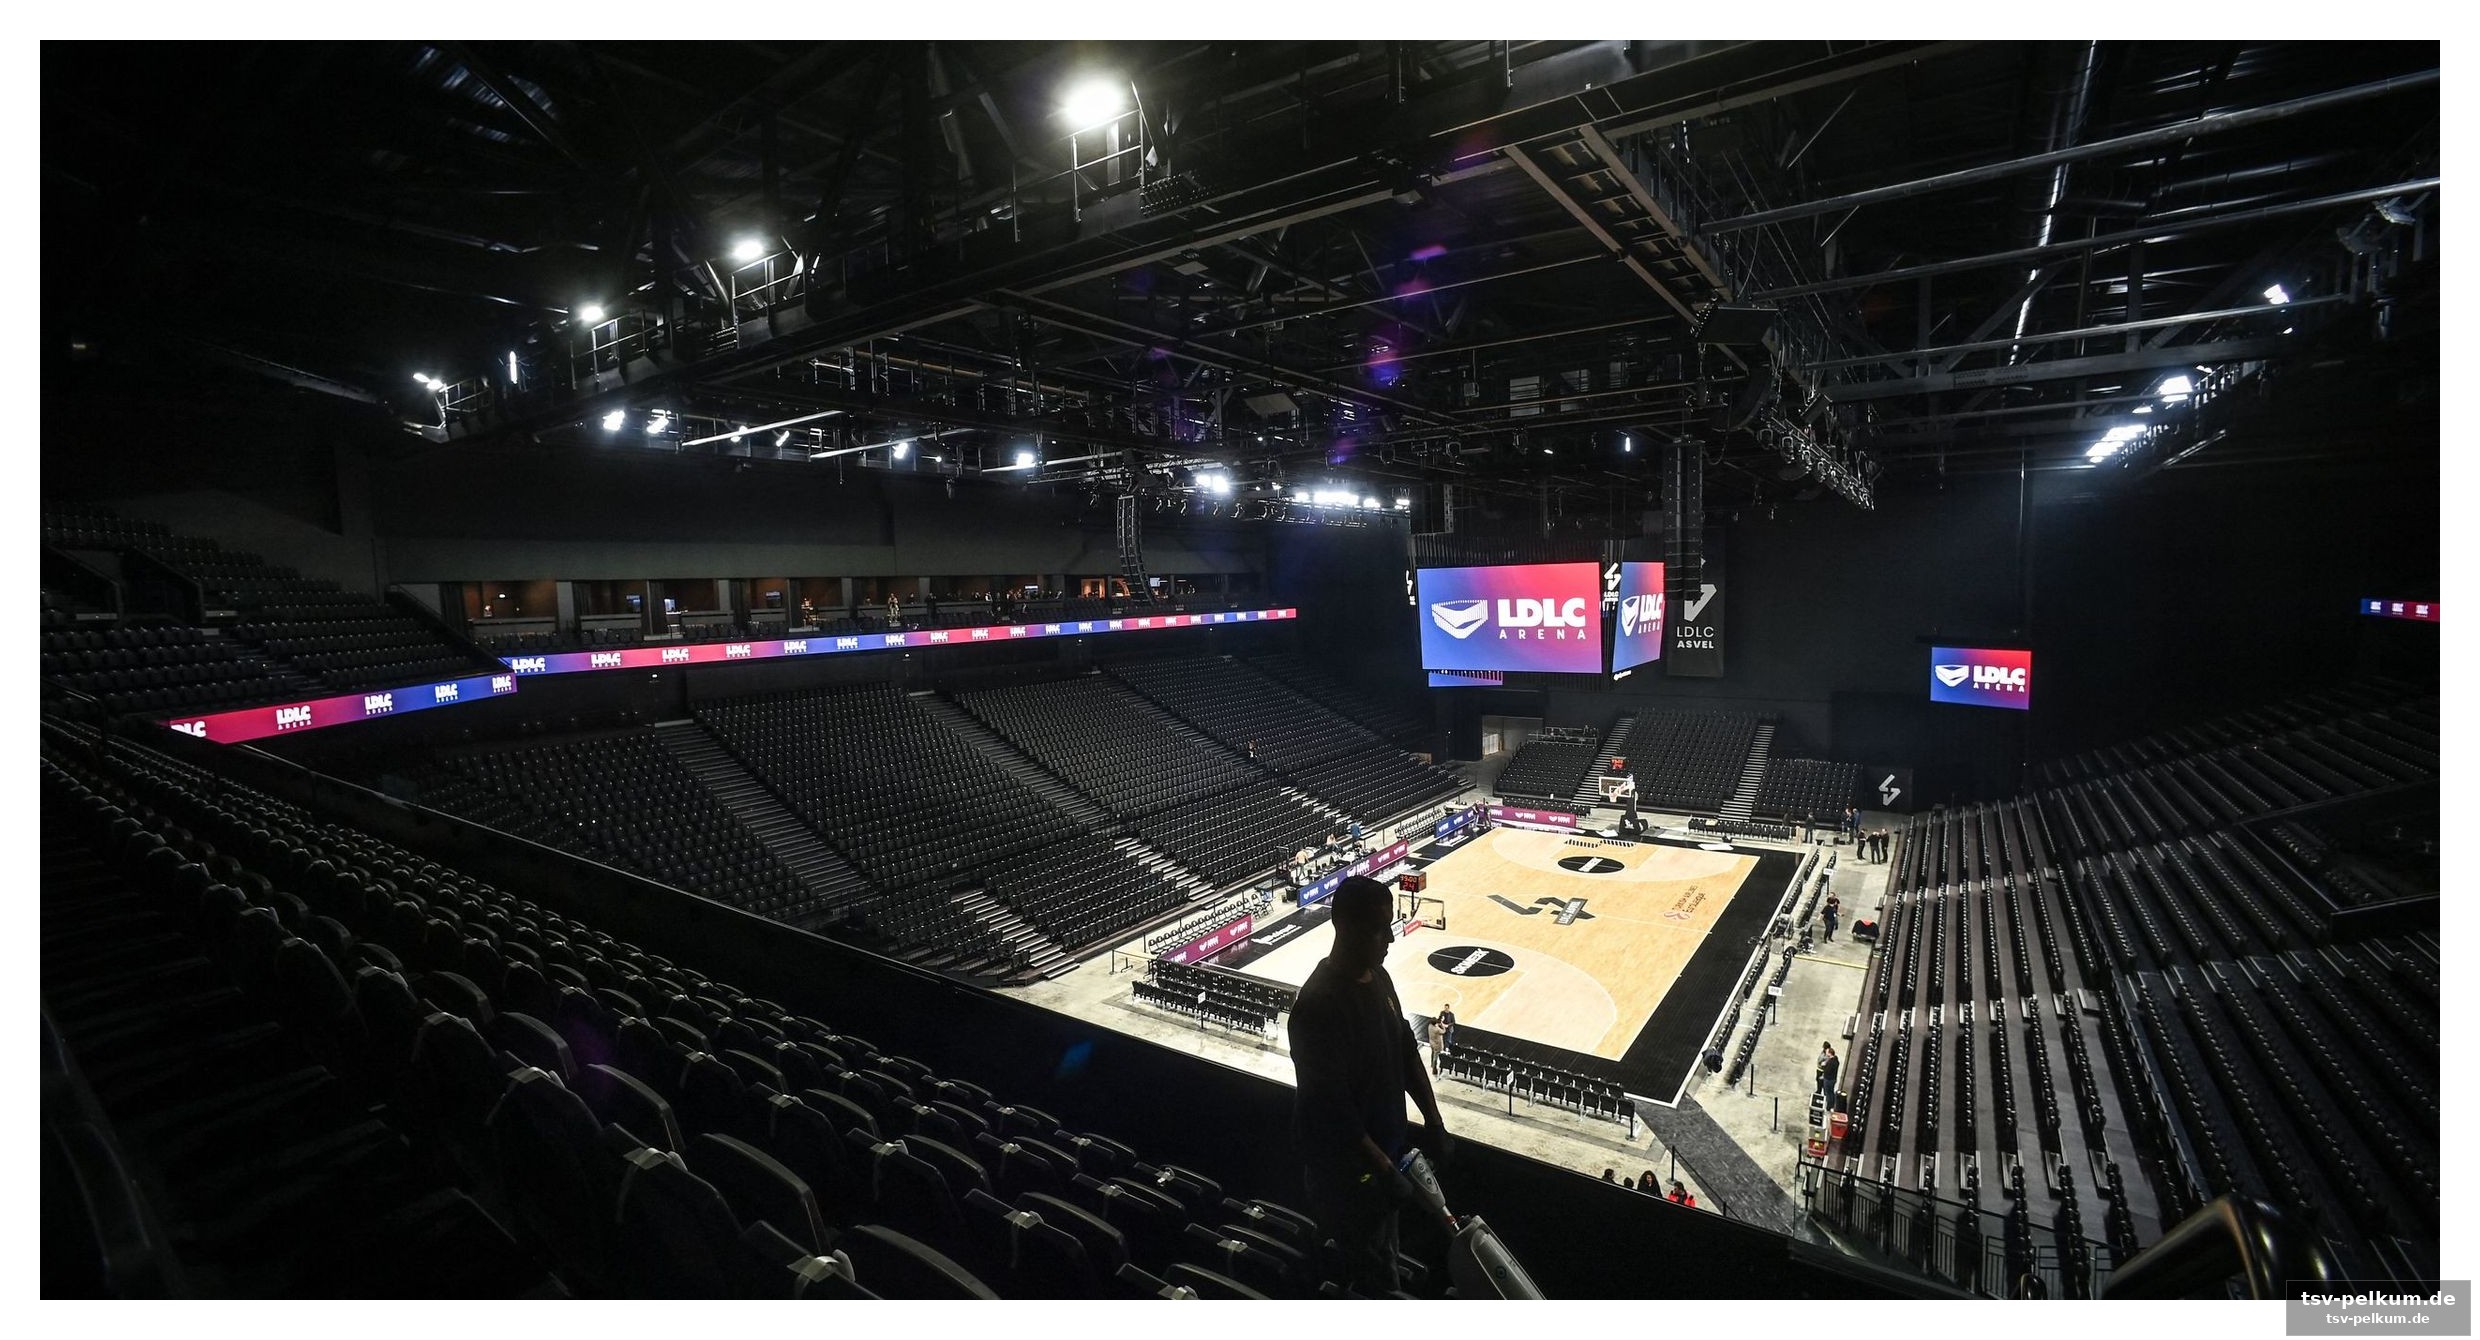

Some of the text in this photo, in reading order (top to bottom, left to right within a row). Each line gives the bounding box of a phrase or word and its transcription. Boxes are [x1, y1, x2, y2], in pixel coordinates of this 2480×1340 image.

[1498, 598, 1586, 627] LDLC
[1639, 593, 1664, 622] LDLC
[1499, 629, 1586, 640] ARENA
[1677, 626, 1714, 638] LDLC
[1677, 640, 1714, 649] ASVEL
[512, 657, 546, 670] LDLC
[492, 675, 511, 689] LDLC
[1973, 665, 2026, 686] LDLC
[435, 683, 458, 699] LDLC
[1973, 682, 2025, 692] ARENA
[364, 693, 393, 710] LDLC
[276, 705, 311, 725] LDLC
